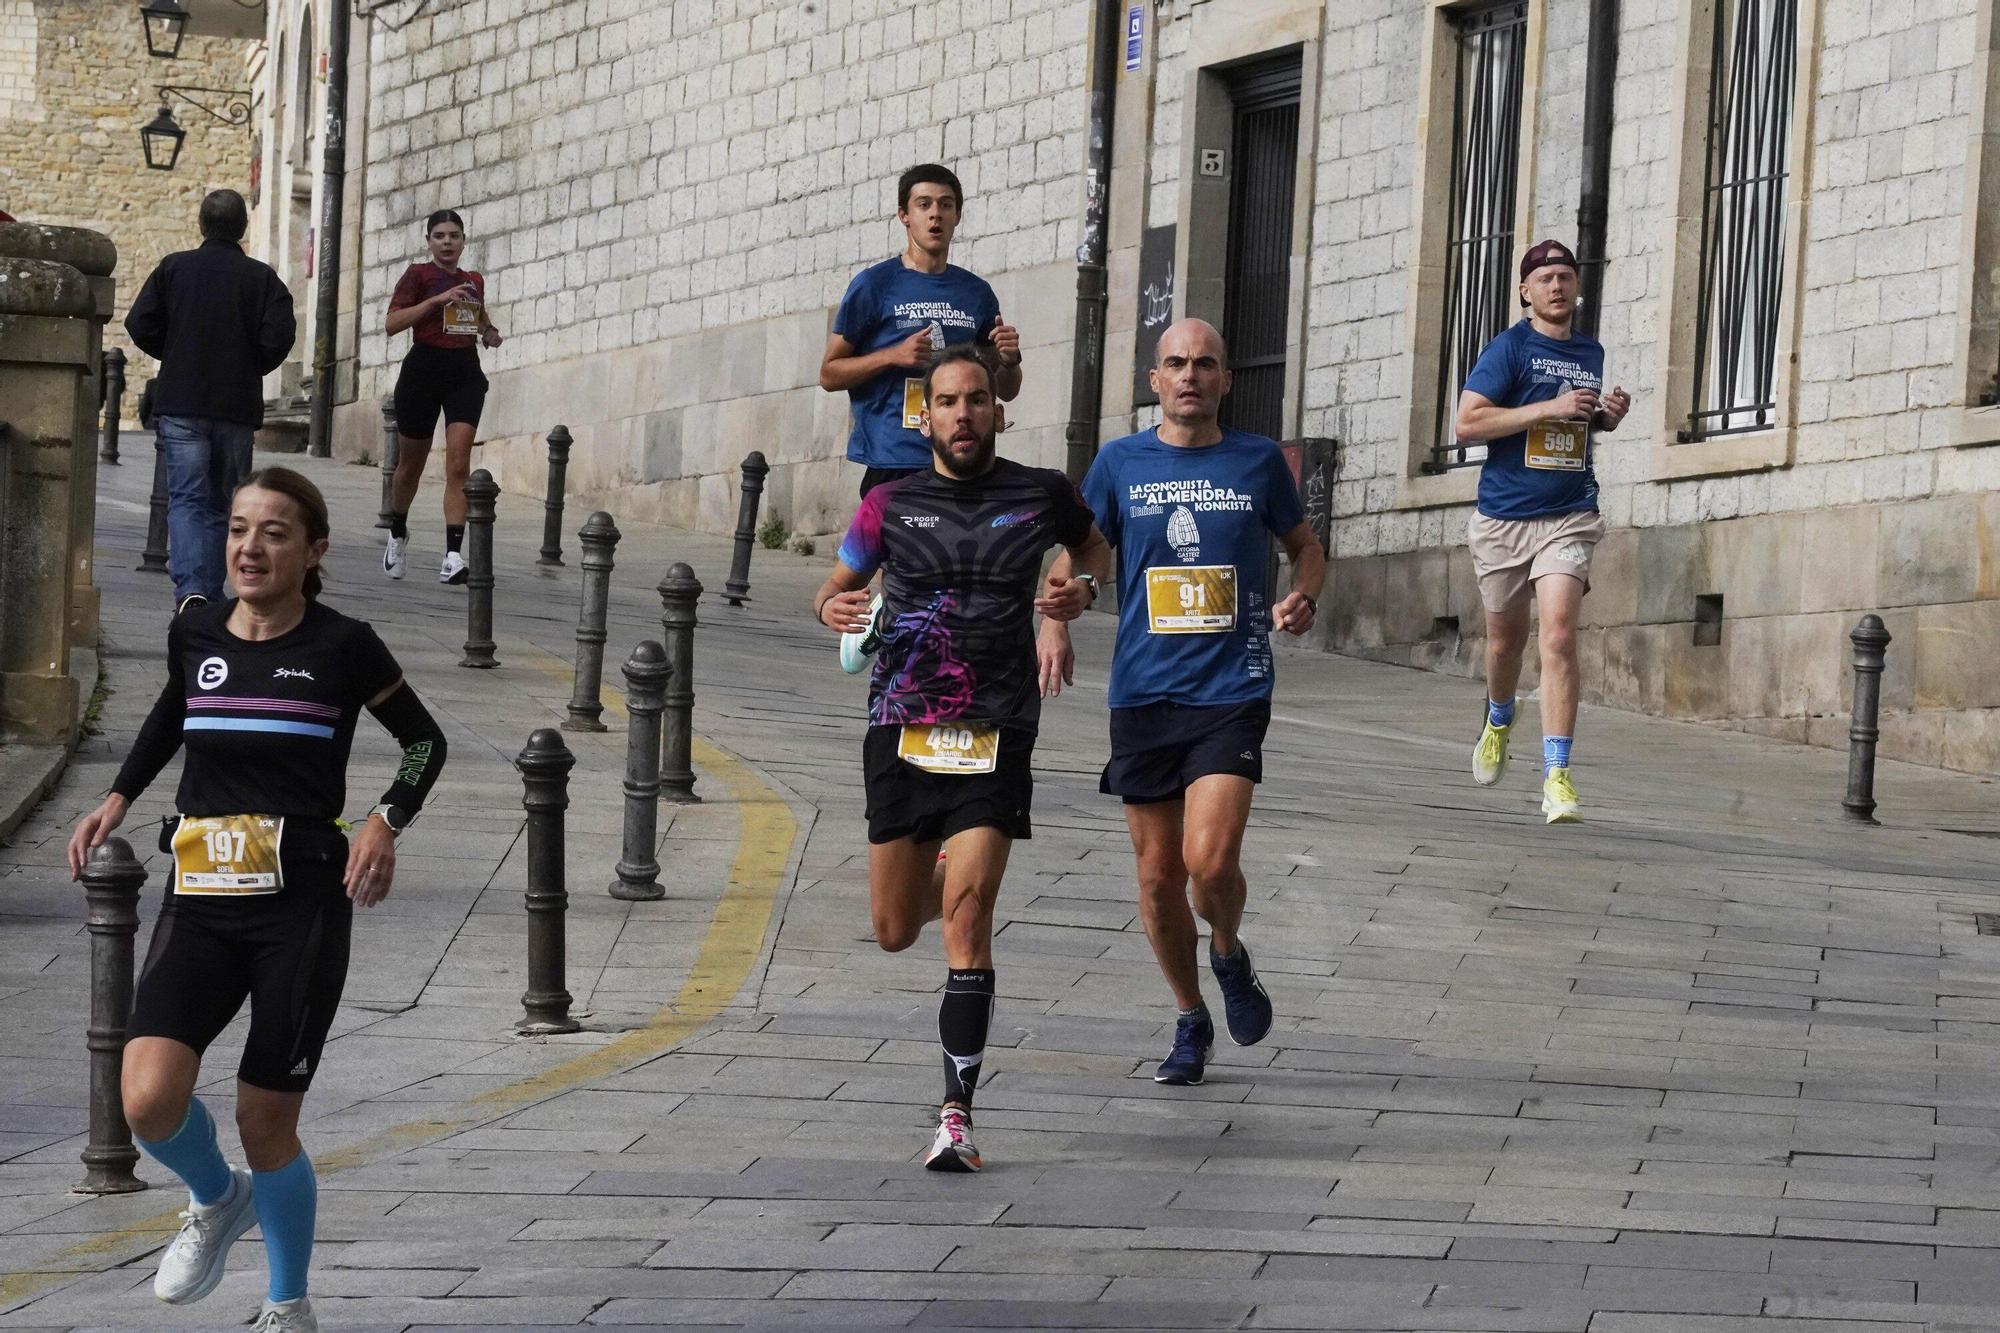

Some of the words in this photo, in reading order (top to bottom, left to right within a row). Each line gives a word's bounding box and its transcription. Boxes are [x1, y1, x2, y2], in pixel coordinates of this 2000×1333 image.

[905, 302, 951, 310] CONQUISTA
[909, 309, 966, 320] ALMENDRA
[942, 319, 976, 328] KONKISTA
[1542, 359, 1581, 370] CONQUISTA
[1545, 366, 1595, 381] ALMENDRA
[1544, 432, 1575, 452] 599
[1129, 484, 1143, 494] LA
[1144, 479, 1212, 493] CONQUISTA
[1146, 488, 1237, 505] ALMENDRA
[1195, 501, 1253, 511] KONKISTA
[1180, 583, 1205, 608] 91
[273, 668, 314, 681] Spiuk
[926, 727, 974, 750] 490
[259, 819, 274, 827] 10K
[202, 831, 246, 863] 197
